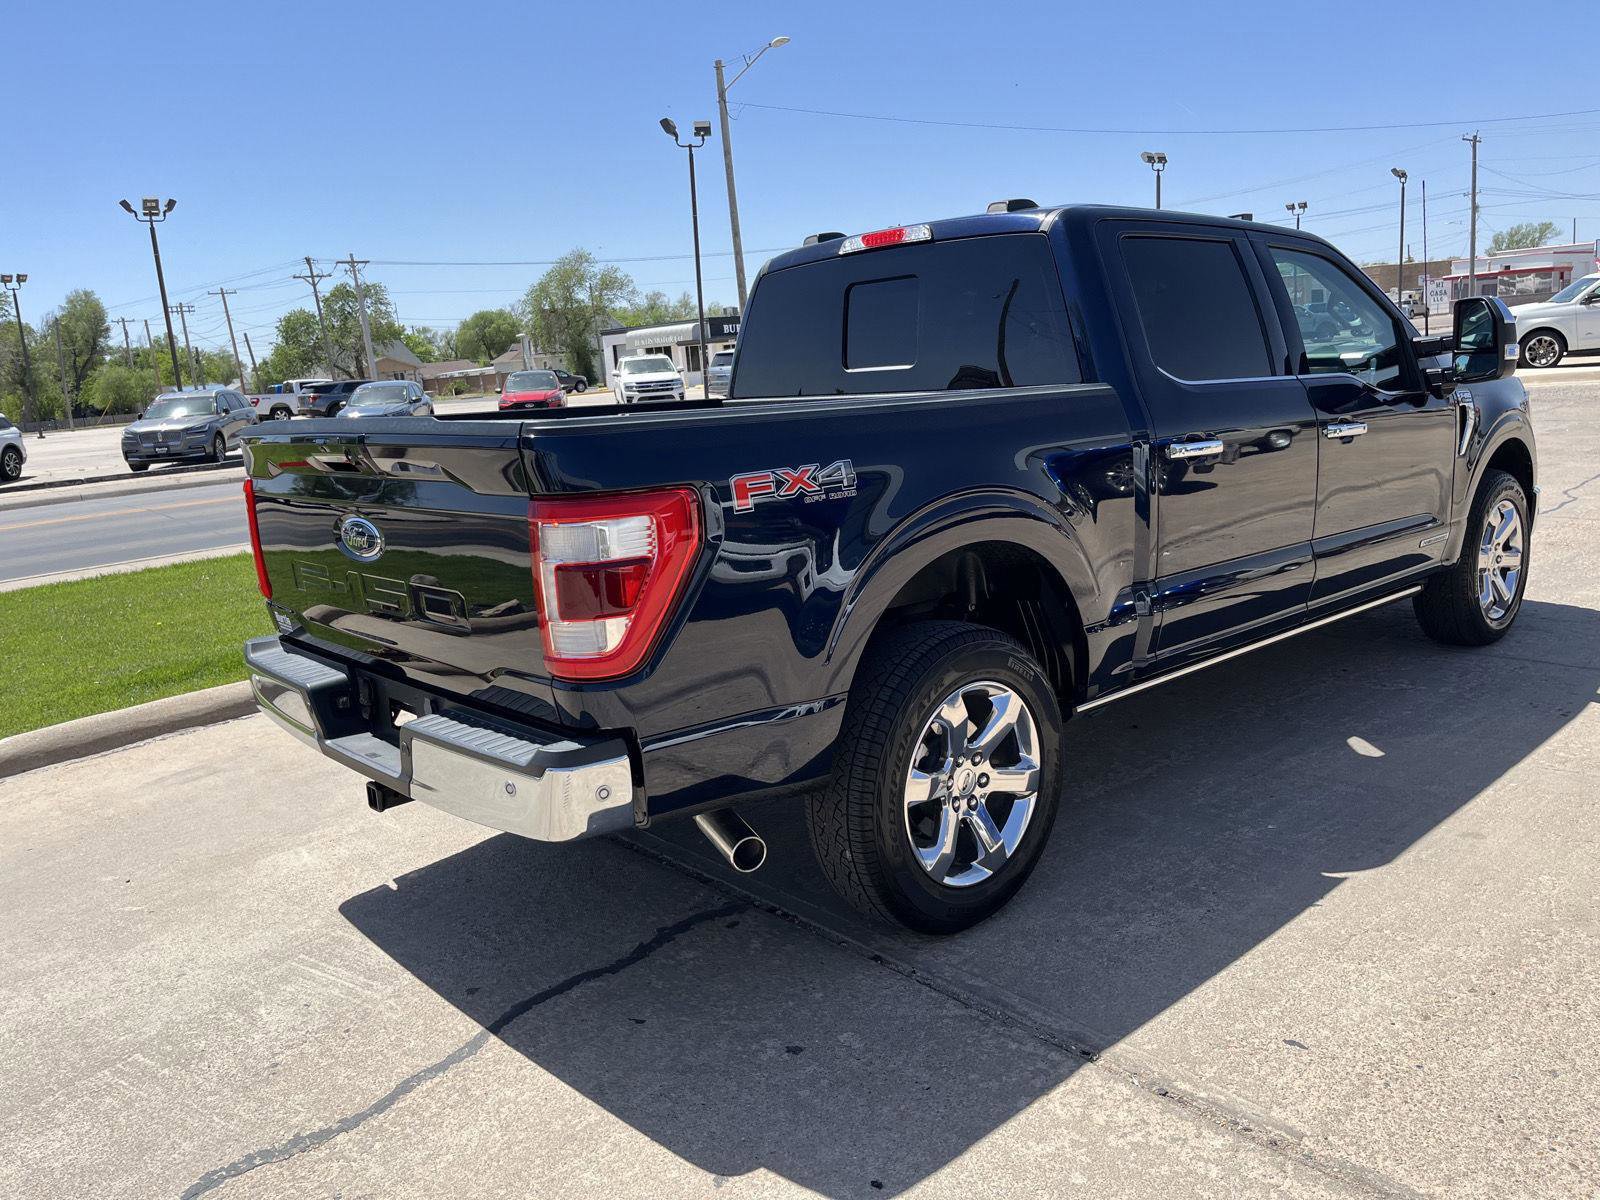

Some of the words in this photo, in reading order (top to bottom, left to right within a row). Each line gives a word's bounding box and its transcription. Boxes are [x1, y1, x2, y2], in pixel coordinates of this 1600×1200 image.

[729, 459, 858, 514] FX4
[804, 495, 827, 504] OFF
[829, 490, 858, 499] ROAD
[1007, 656, 1034, 682] PIRELLI
